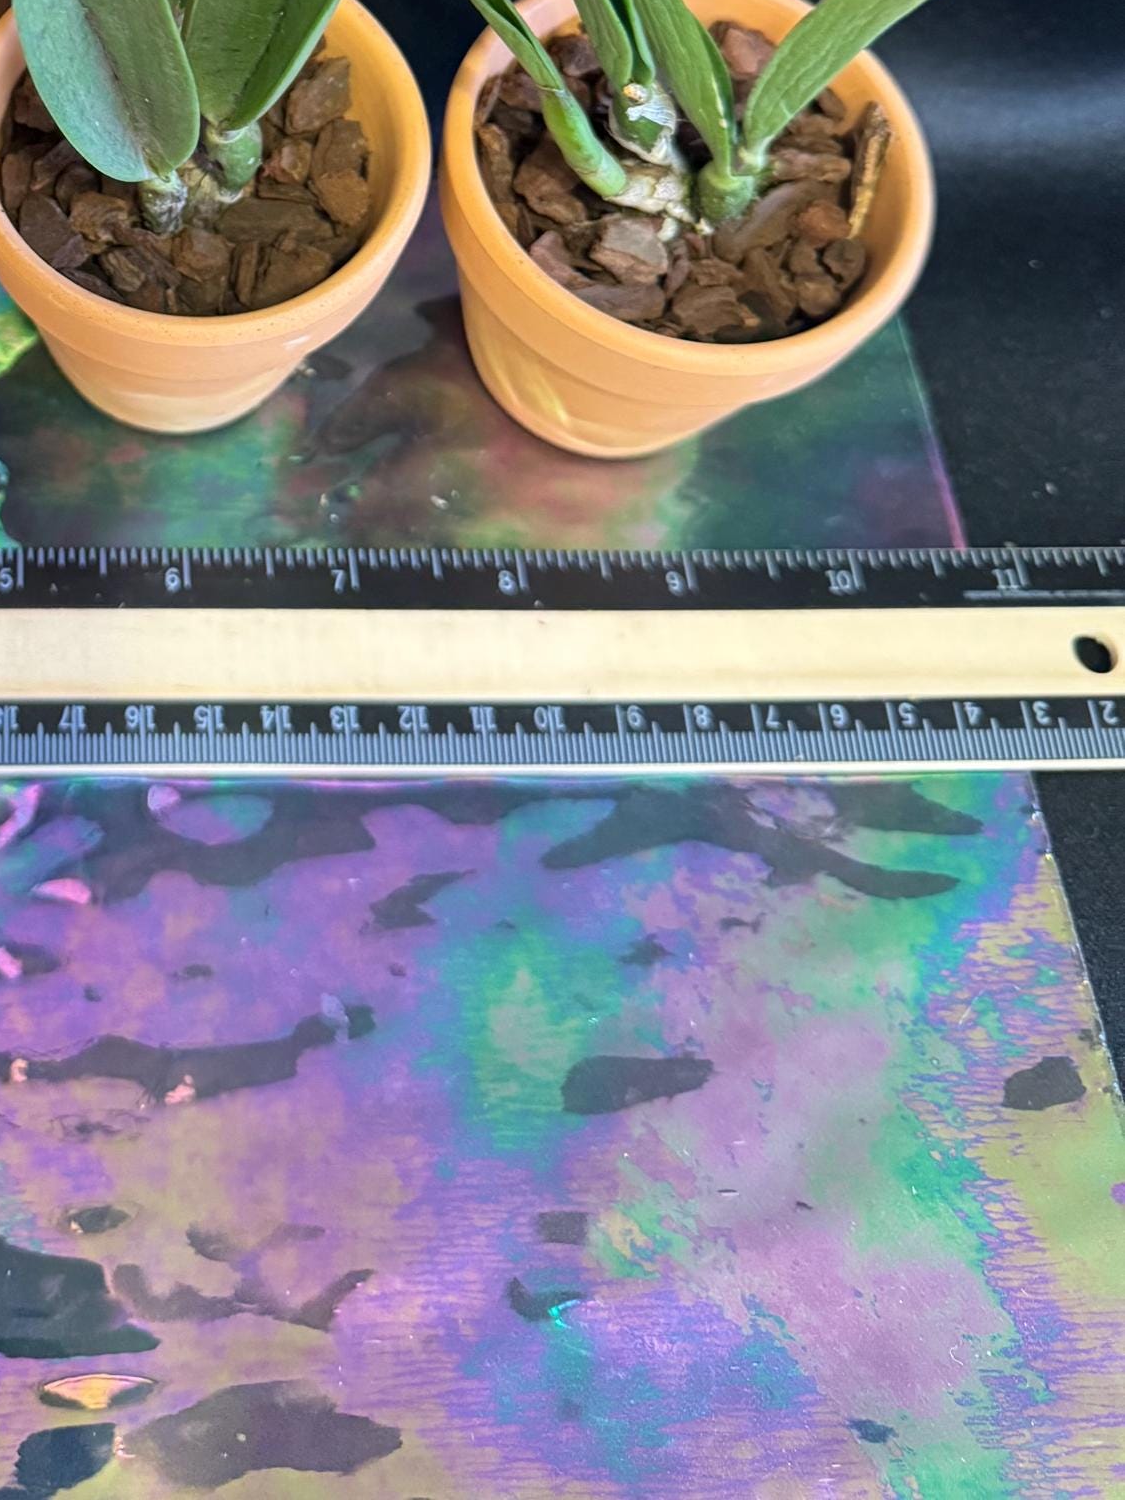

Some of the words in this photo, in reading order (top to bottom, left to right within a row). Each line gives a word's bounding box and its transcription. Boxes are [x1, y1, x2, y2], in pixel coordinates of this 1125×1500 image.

[165, 567, 181, 592] 6
[331, 569, 346, 593] 7
[498, 570, 518, 595] 8
[665, 571, 685, 596] 9
[826, 570, 854, 596] 10
[991, 569, 1021, 589] 11
[59, 706, 86, 729] 17
[125, 706, 155, 729] 16
[194, 706, 224, 730] 15
[260, 706, 292, 730] 14
[330, 706, 361, 730] 13
[398, 706, 429, 730] 12
[469, 706, 497, 730] 11
[534, 706, 566, 730] 10
[627, 706, 645, 730] 9
[693, 705, 714, 729] 8
[766, 705, 781, 728] 7
[830, 704, 849, 728] 6
[899, 702, 917, 727] 5
[963, 702, 983, 726] 4
[1033, 701, 1050, 725] 3
[1099, 701, 1119, 725] 2
